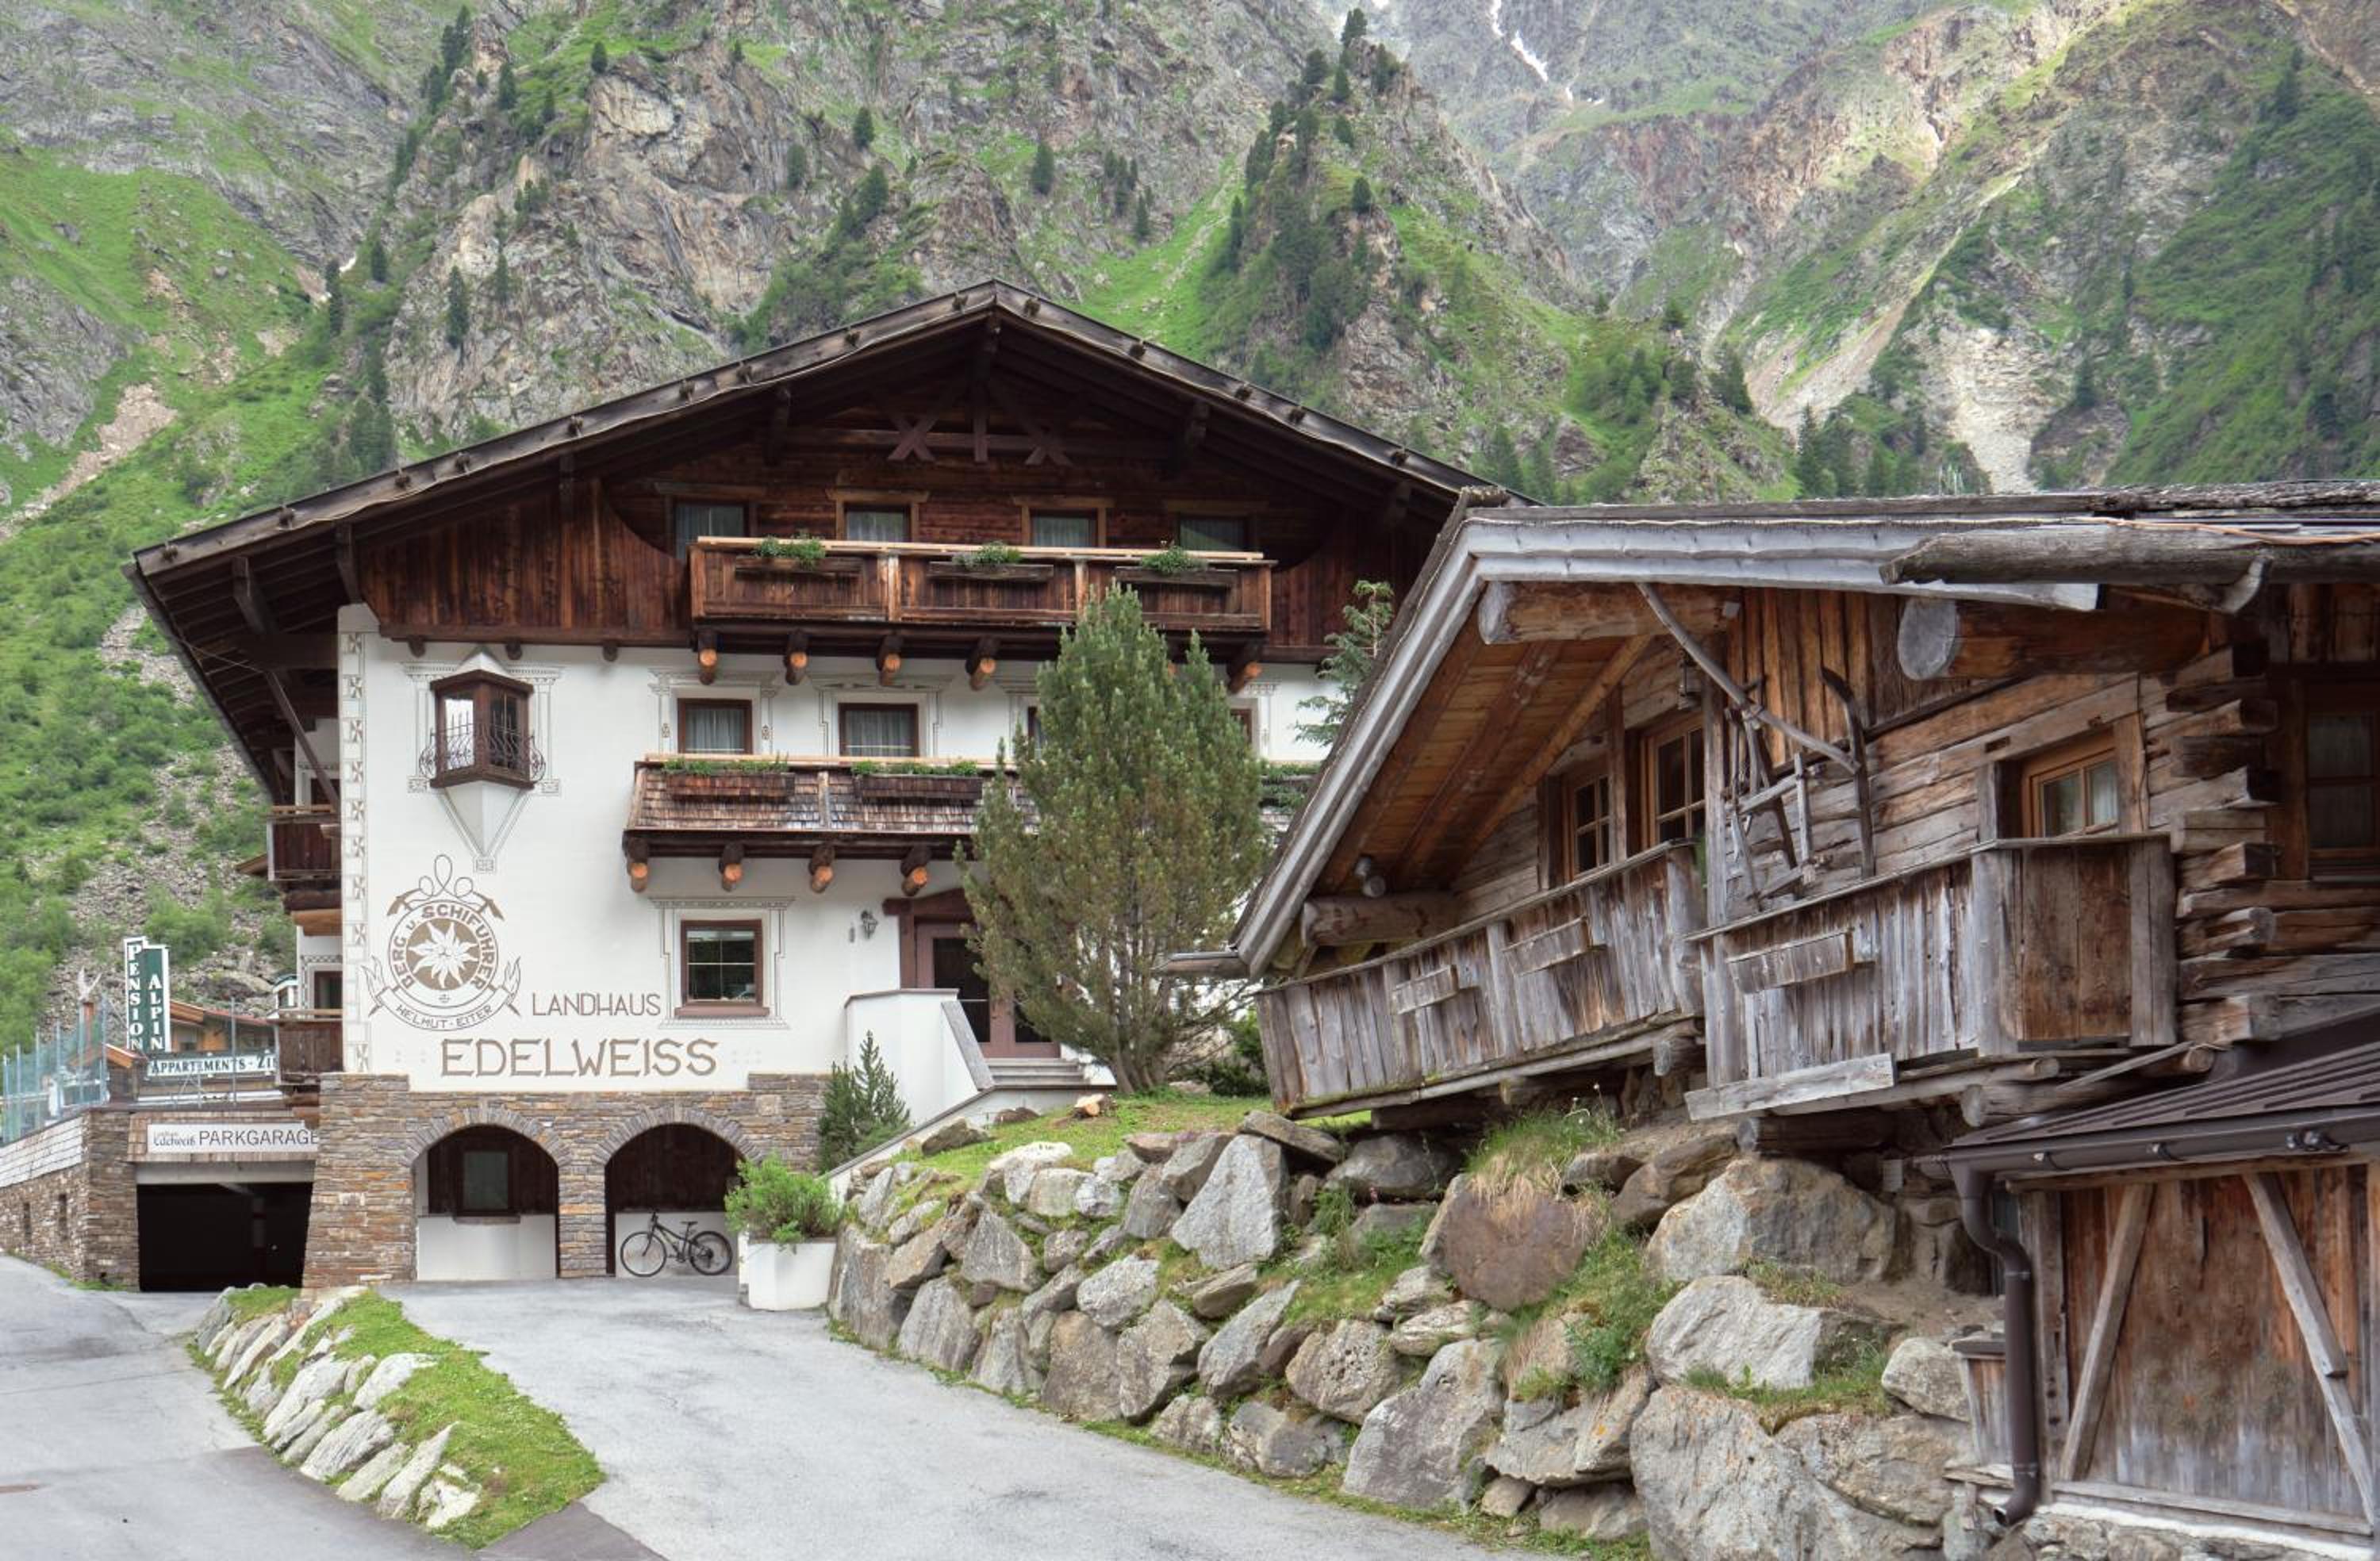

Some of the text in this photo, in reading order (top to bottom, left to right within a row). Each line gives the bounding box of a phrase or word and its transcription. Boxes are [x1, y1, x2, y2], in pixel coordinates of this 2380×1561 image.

[393, 936, 415, 989] BERG
[128, 944, 144, 1050] PENSION
[148, 974, 163, 1050] ALPIN
[396, 1004, 447, 1029] HELMUT
[456, 1004, 493, 1027] EITER
[532, 993, 661, 1017] LANDHAUS
[440, 1038, 719, 1078] EDELWEISS
[199, 1130, 317, 1146] PARKGARAGE
